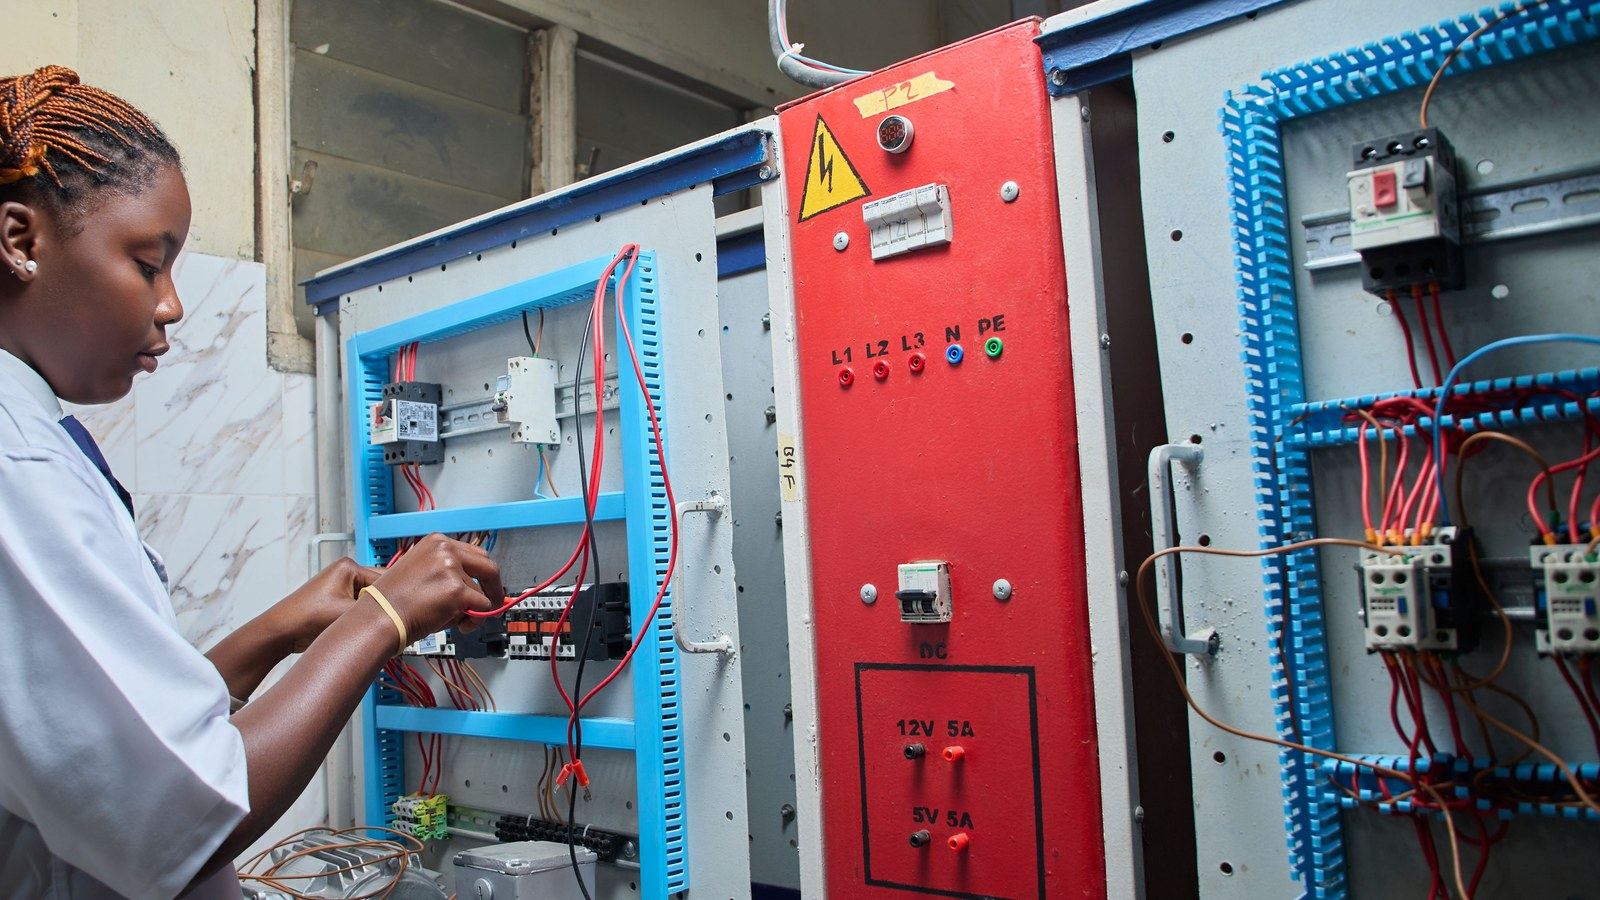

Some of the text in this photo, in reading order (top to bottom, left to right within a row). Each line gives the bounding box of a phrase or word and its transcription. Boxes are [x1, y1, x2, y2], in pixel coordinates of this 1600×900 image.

[832, 314, 1006, 366] L1 L2 L3 N PE
[920, 642, 948, 659] DC
[897, 719, 975, 738] 12V 5A
[913, 806, 974, 830] 5V 5A
